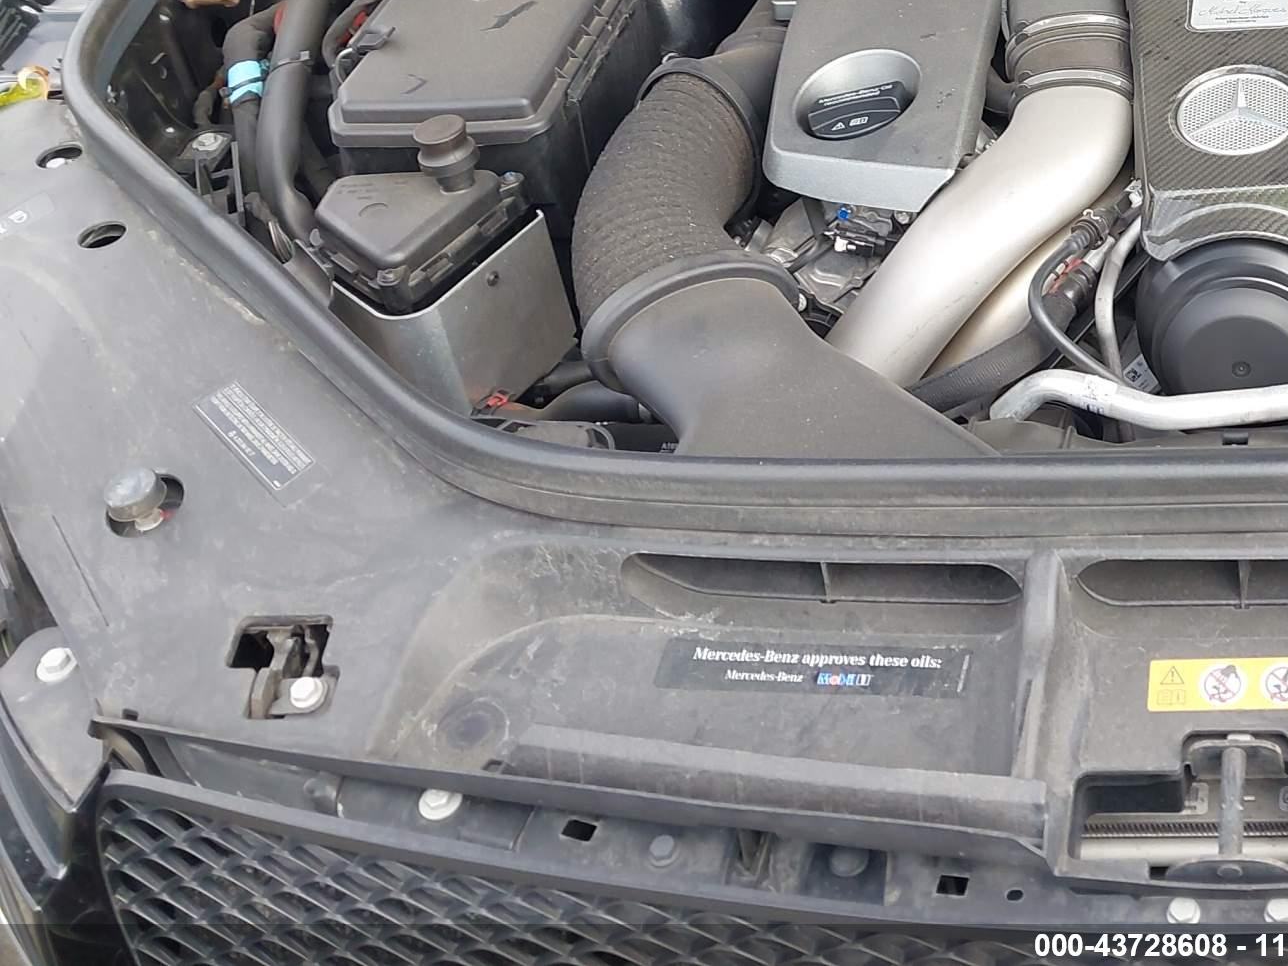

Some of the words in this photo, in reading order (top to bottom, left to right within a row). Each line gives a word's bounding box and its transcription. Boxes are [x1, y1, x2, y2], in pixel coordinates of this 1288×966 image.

[693, 646, 800, 664] Mercedes-Benz
[801, 653, 867, 668] approves
[869, 653, 909, 667] these
[910, 654, 943, 669] oils:
[724, 669, 804, 683] Mercedes-Benz
